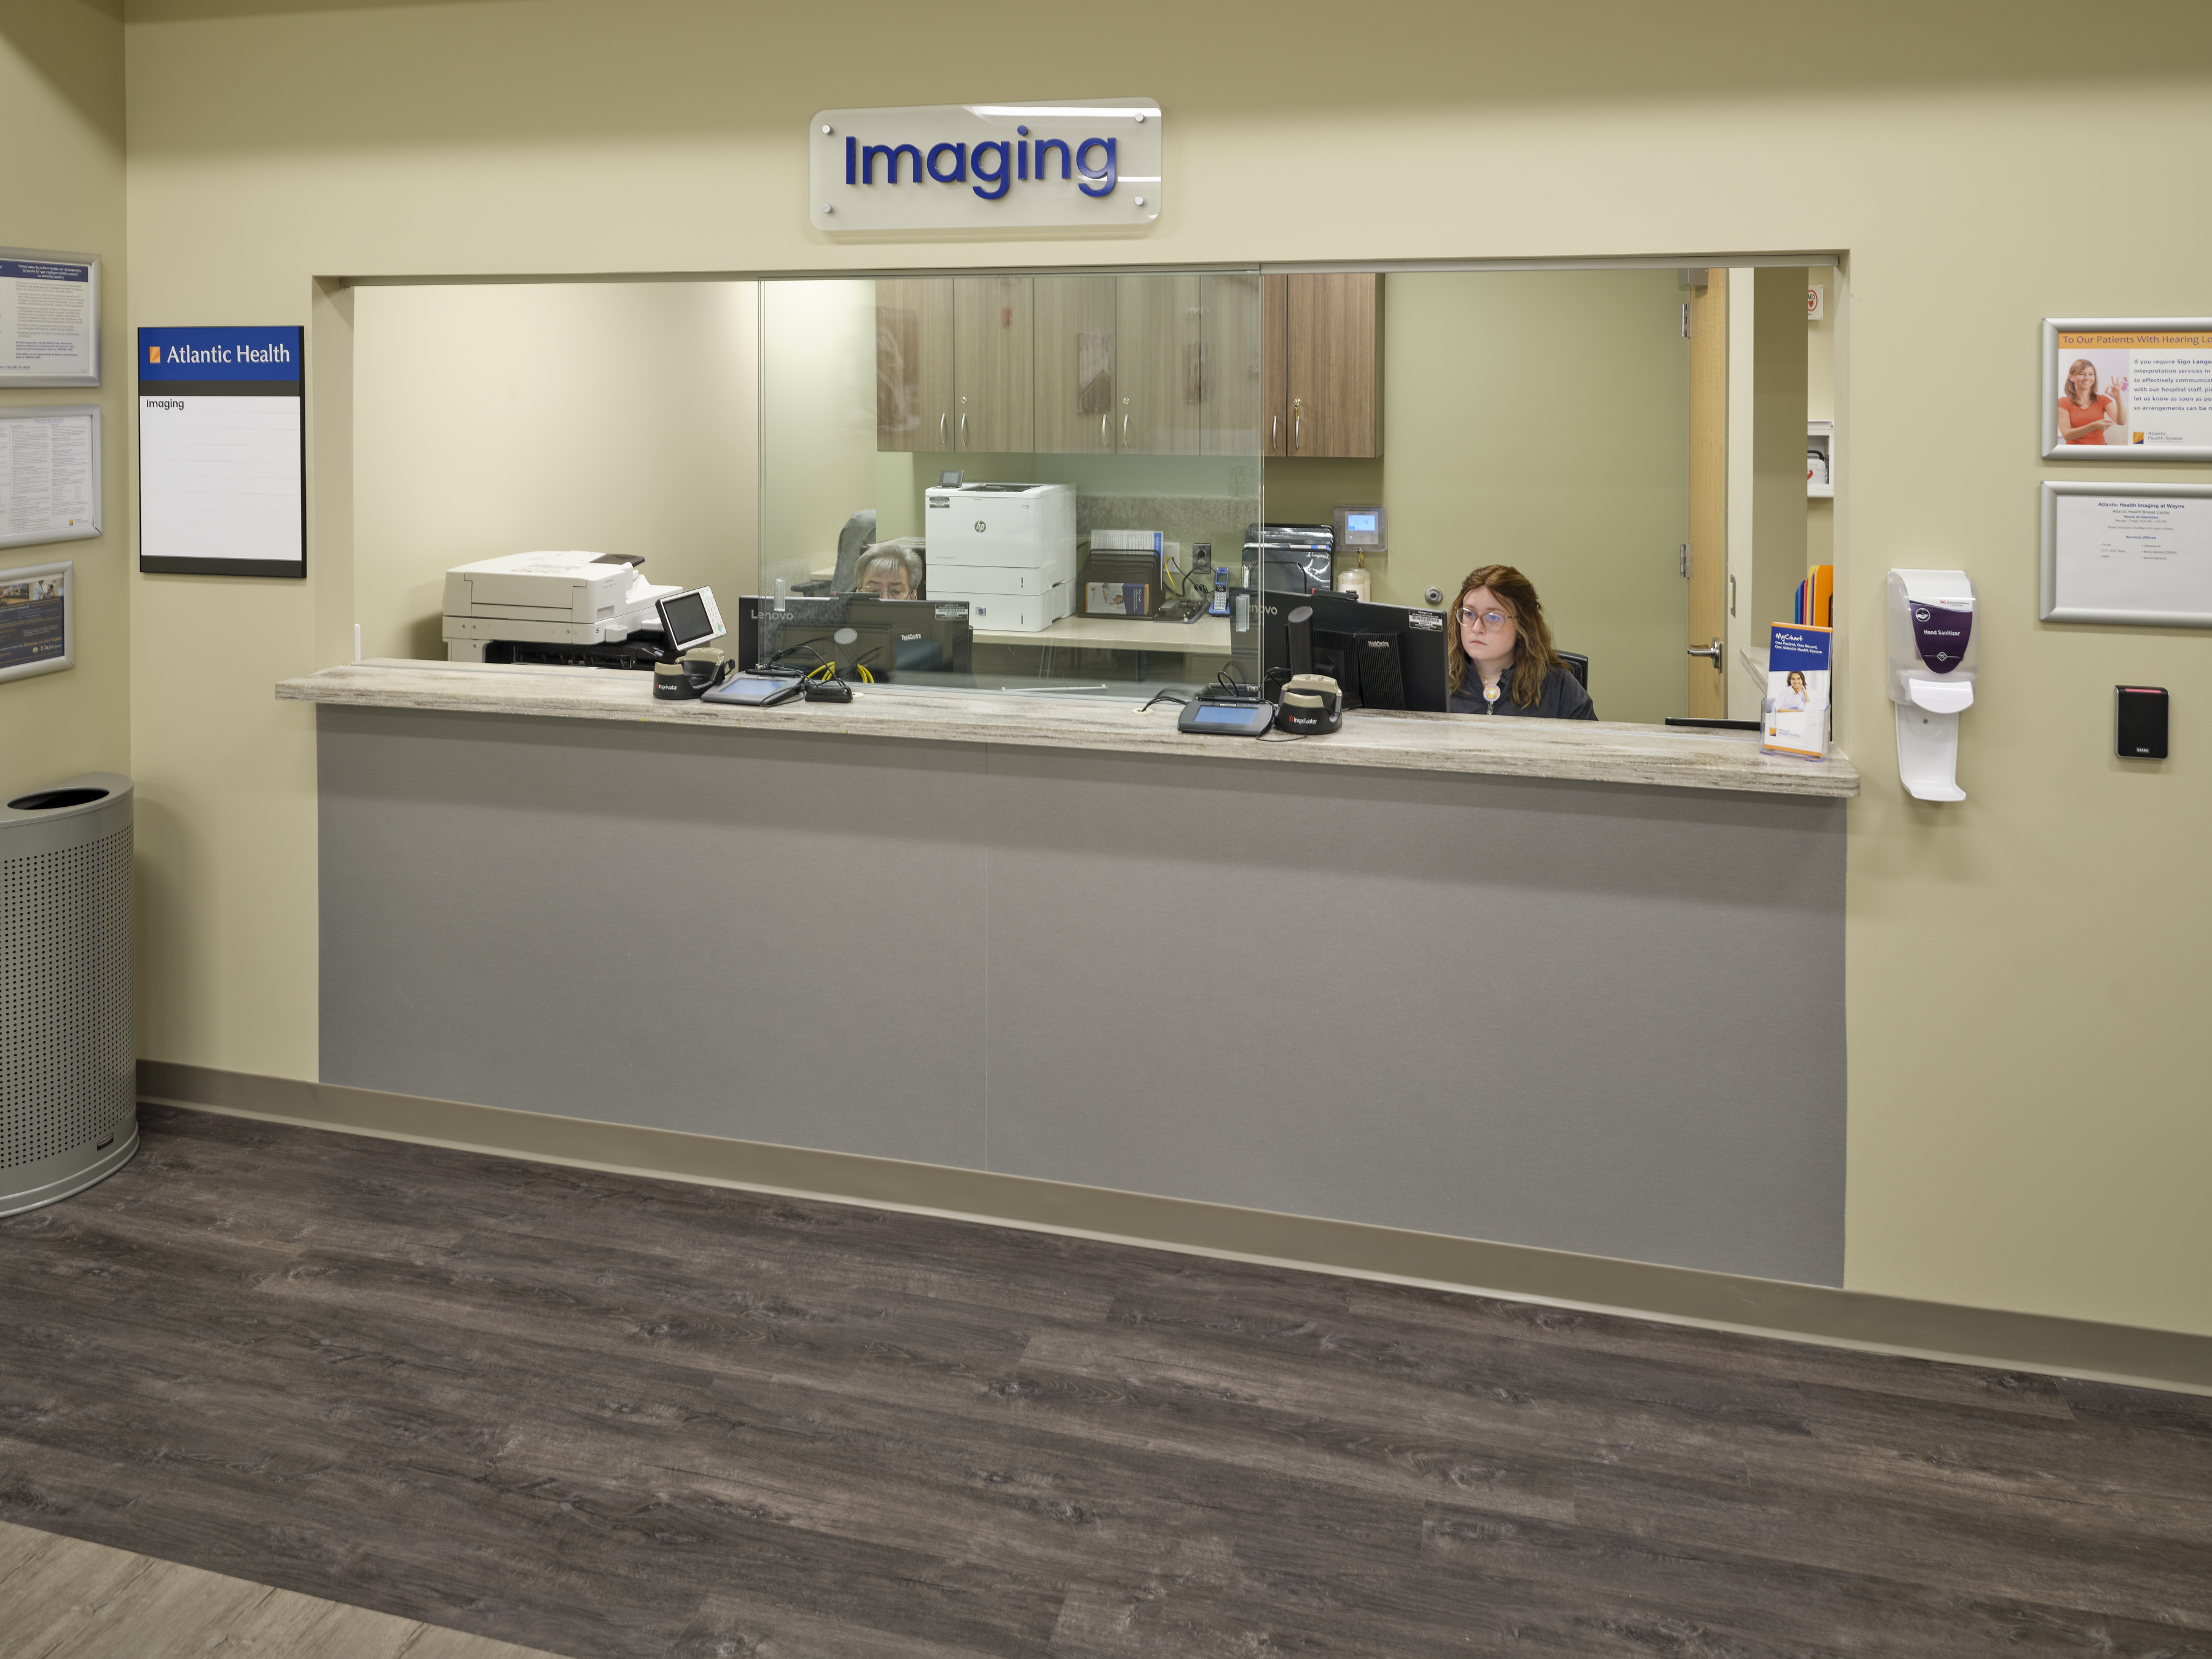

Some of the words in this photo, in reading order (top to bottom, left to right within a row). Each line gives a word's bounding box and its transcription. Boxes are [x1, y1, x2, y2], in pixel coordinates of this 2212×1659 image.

[845, 125, 1117, 200] Imaging
[2162, 336, 2199, 345] Hearing
[167, 344, 232, 363] Atlantic
[236, 343, 290, 363] Health
[146, 399, 184, 410] Imaging
[975, 520, 985, 533] hp
[751, 609, 794, 620] Lenovo
[1775, 633, 1803, 641] MyChart
